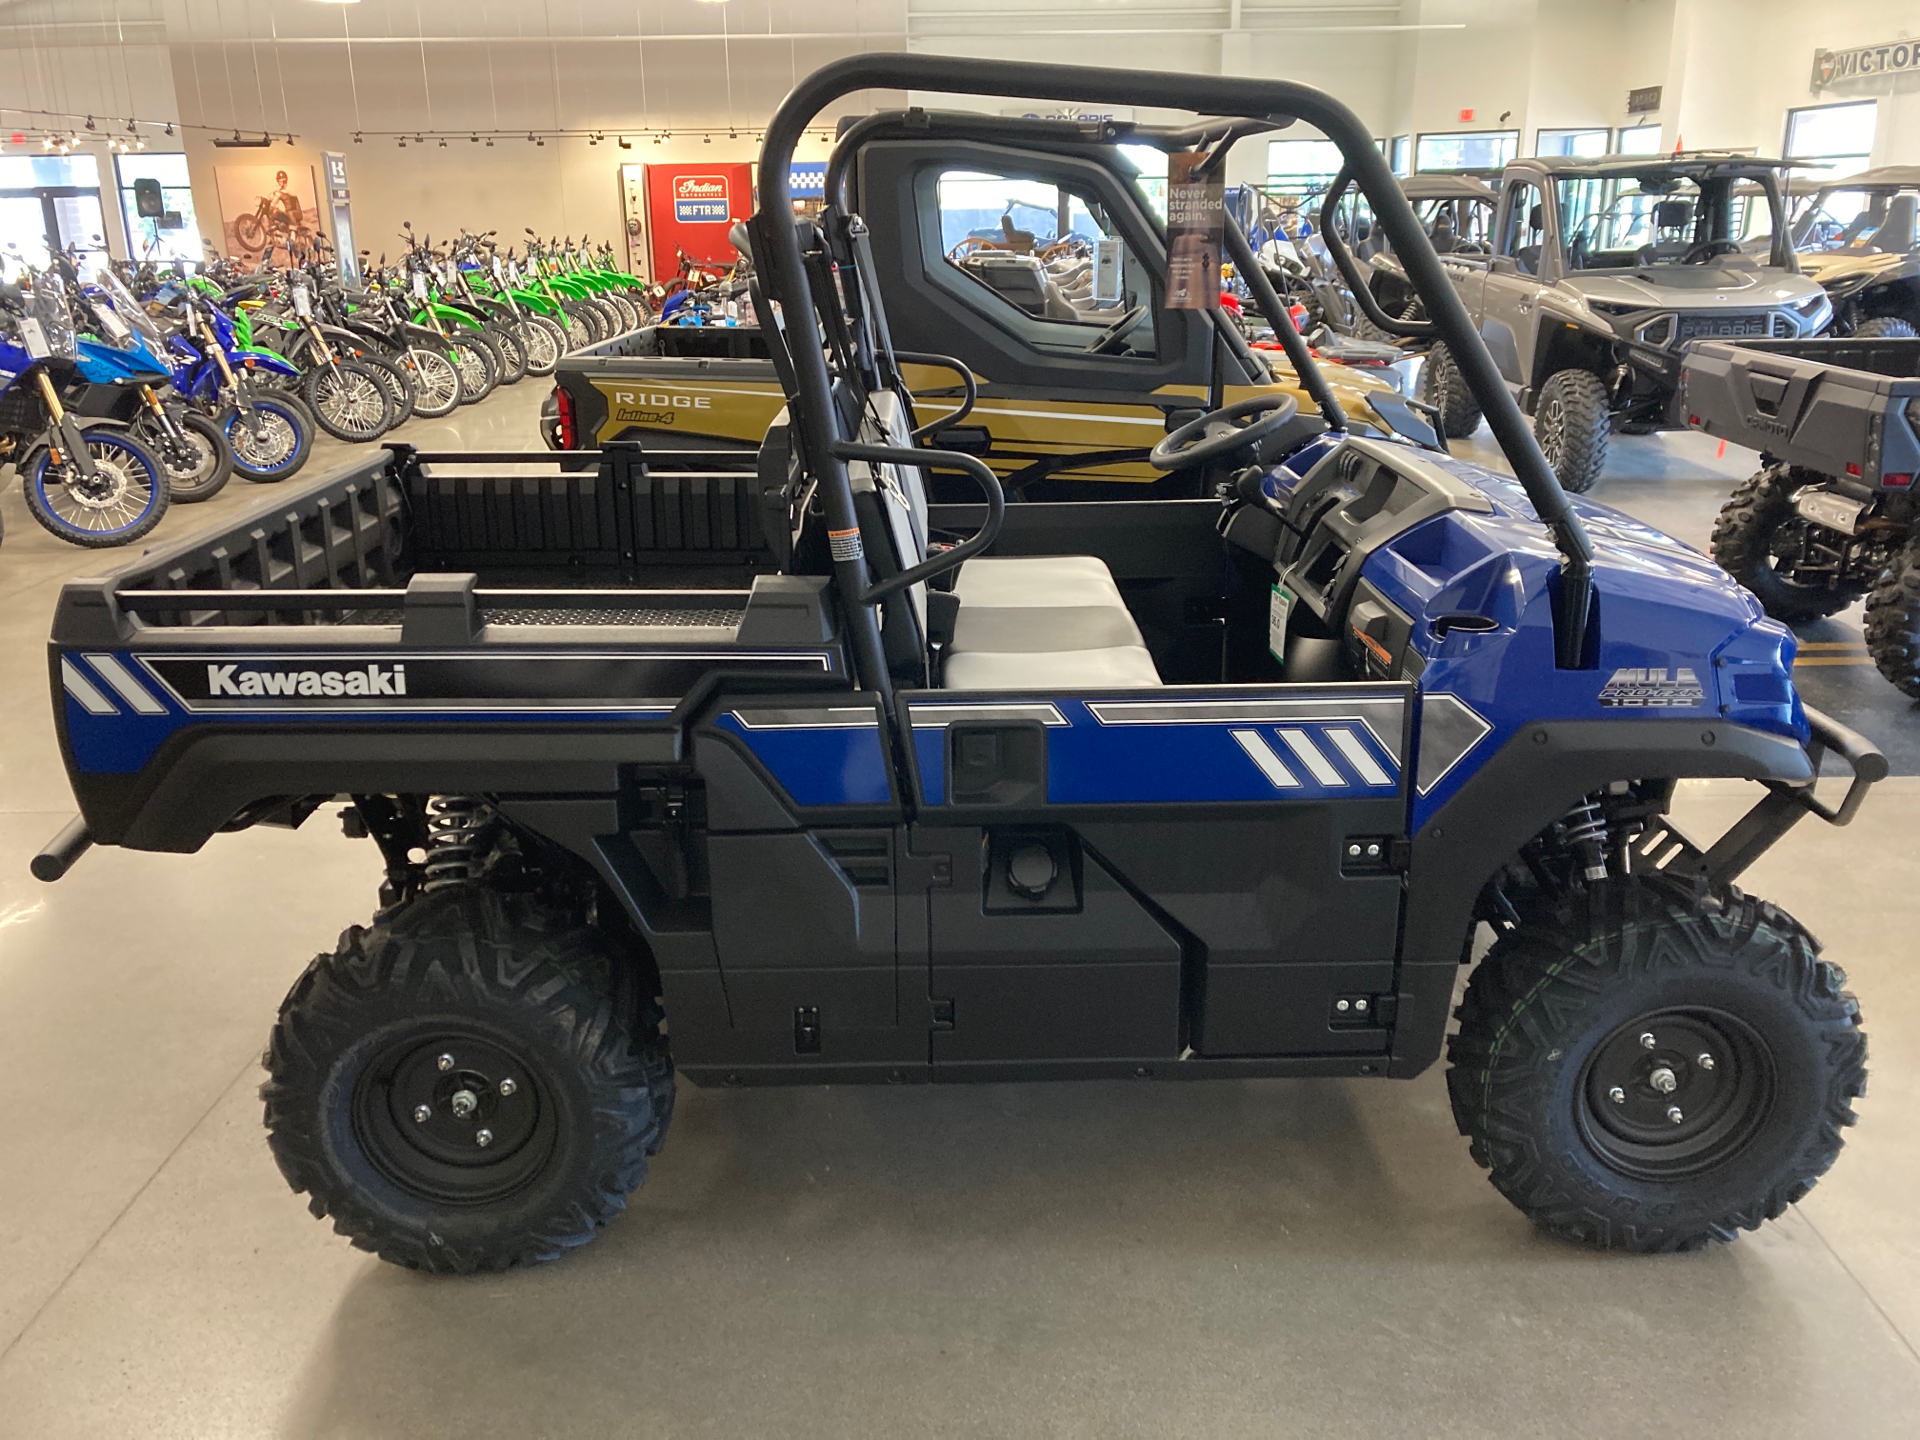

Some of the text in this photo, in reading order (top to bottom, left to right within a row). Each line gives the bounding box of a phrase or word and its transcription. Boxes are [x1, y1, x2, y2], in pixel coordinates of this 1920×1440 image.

[678, 179, 723, 194] Indian
[1169, 188, 1206, 199] Never
[692, 204, 712, 216] FTR
[1169, 198, 1223, 211] stranded
[1169, 211, 1206, 223] again.
[1681, 323, 1763, 337] POLARIS
[615, 391, 711, 409] RIDGE
[616, 408, 675, 424] Inline-4
[207, 664, 407, 696] Kawasaki
[1604, 668, 1701, 689] MULE
[1611, 698, 1694, 706] 1000
